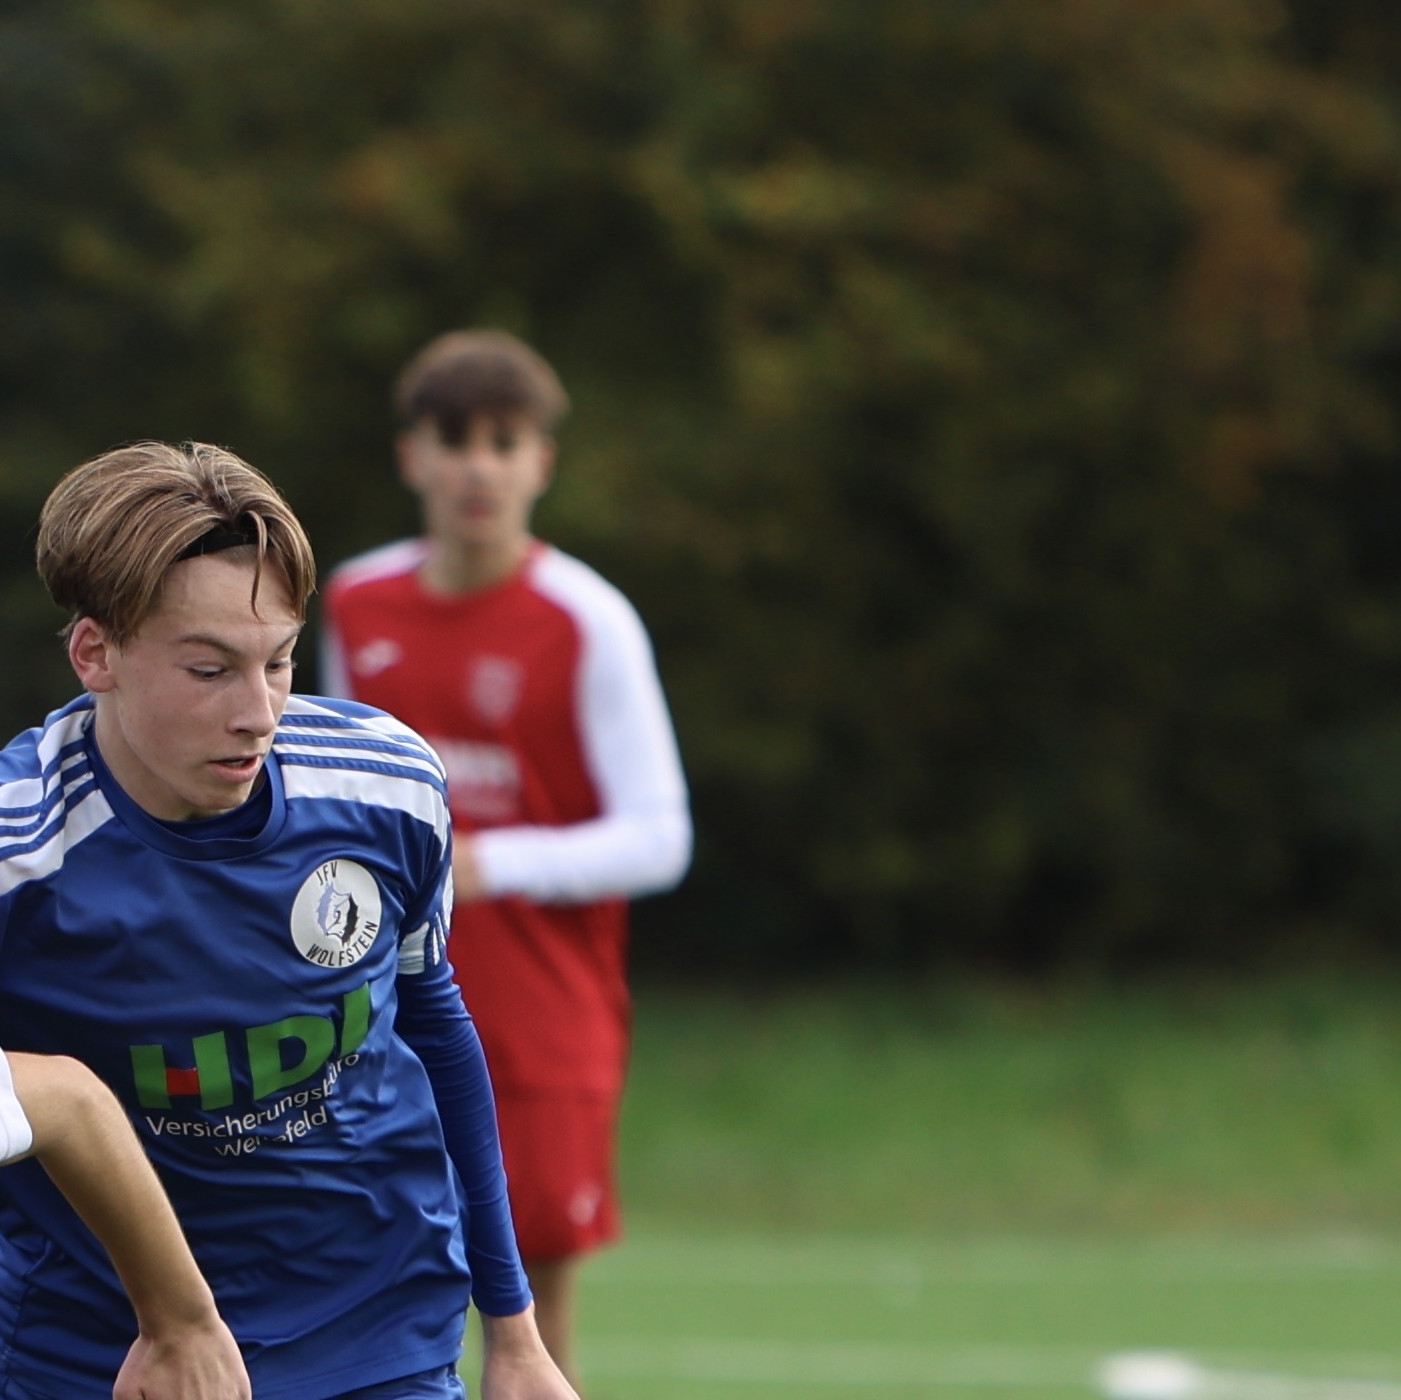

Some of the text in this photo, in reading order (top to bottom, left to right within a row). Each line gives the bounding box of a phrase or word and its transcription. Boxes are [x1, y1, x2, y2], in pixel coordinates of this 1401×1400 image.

[316, 861, 338, 887] JFV
[306, 920, 379, 967] WOLFSTEIN
[129, 981, 372, 1112] HDI
